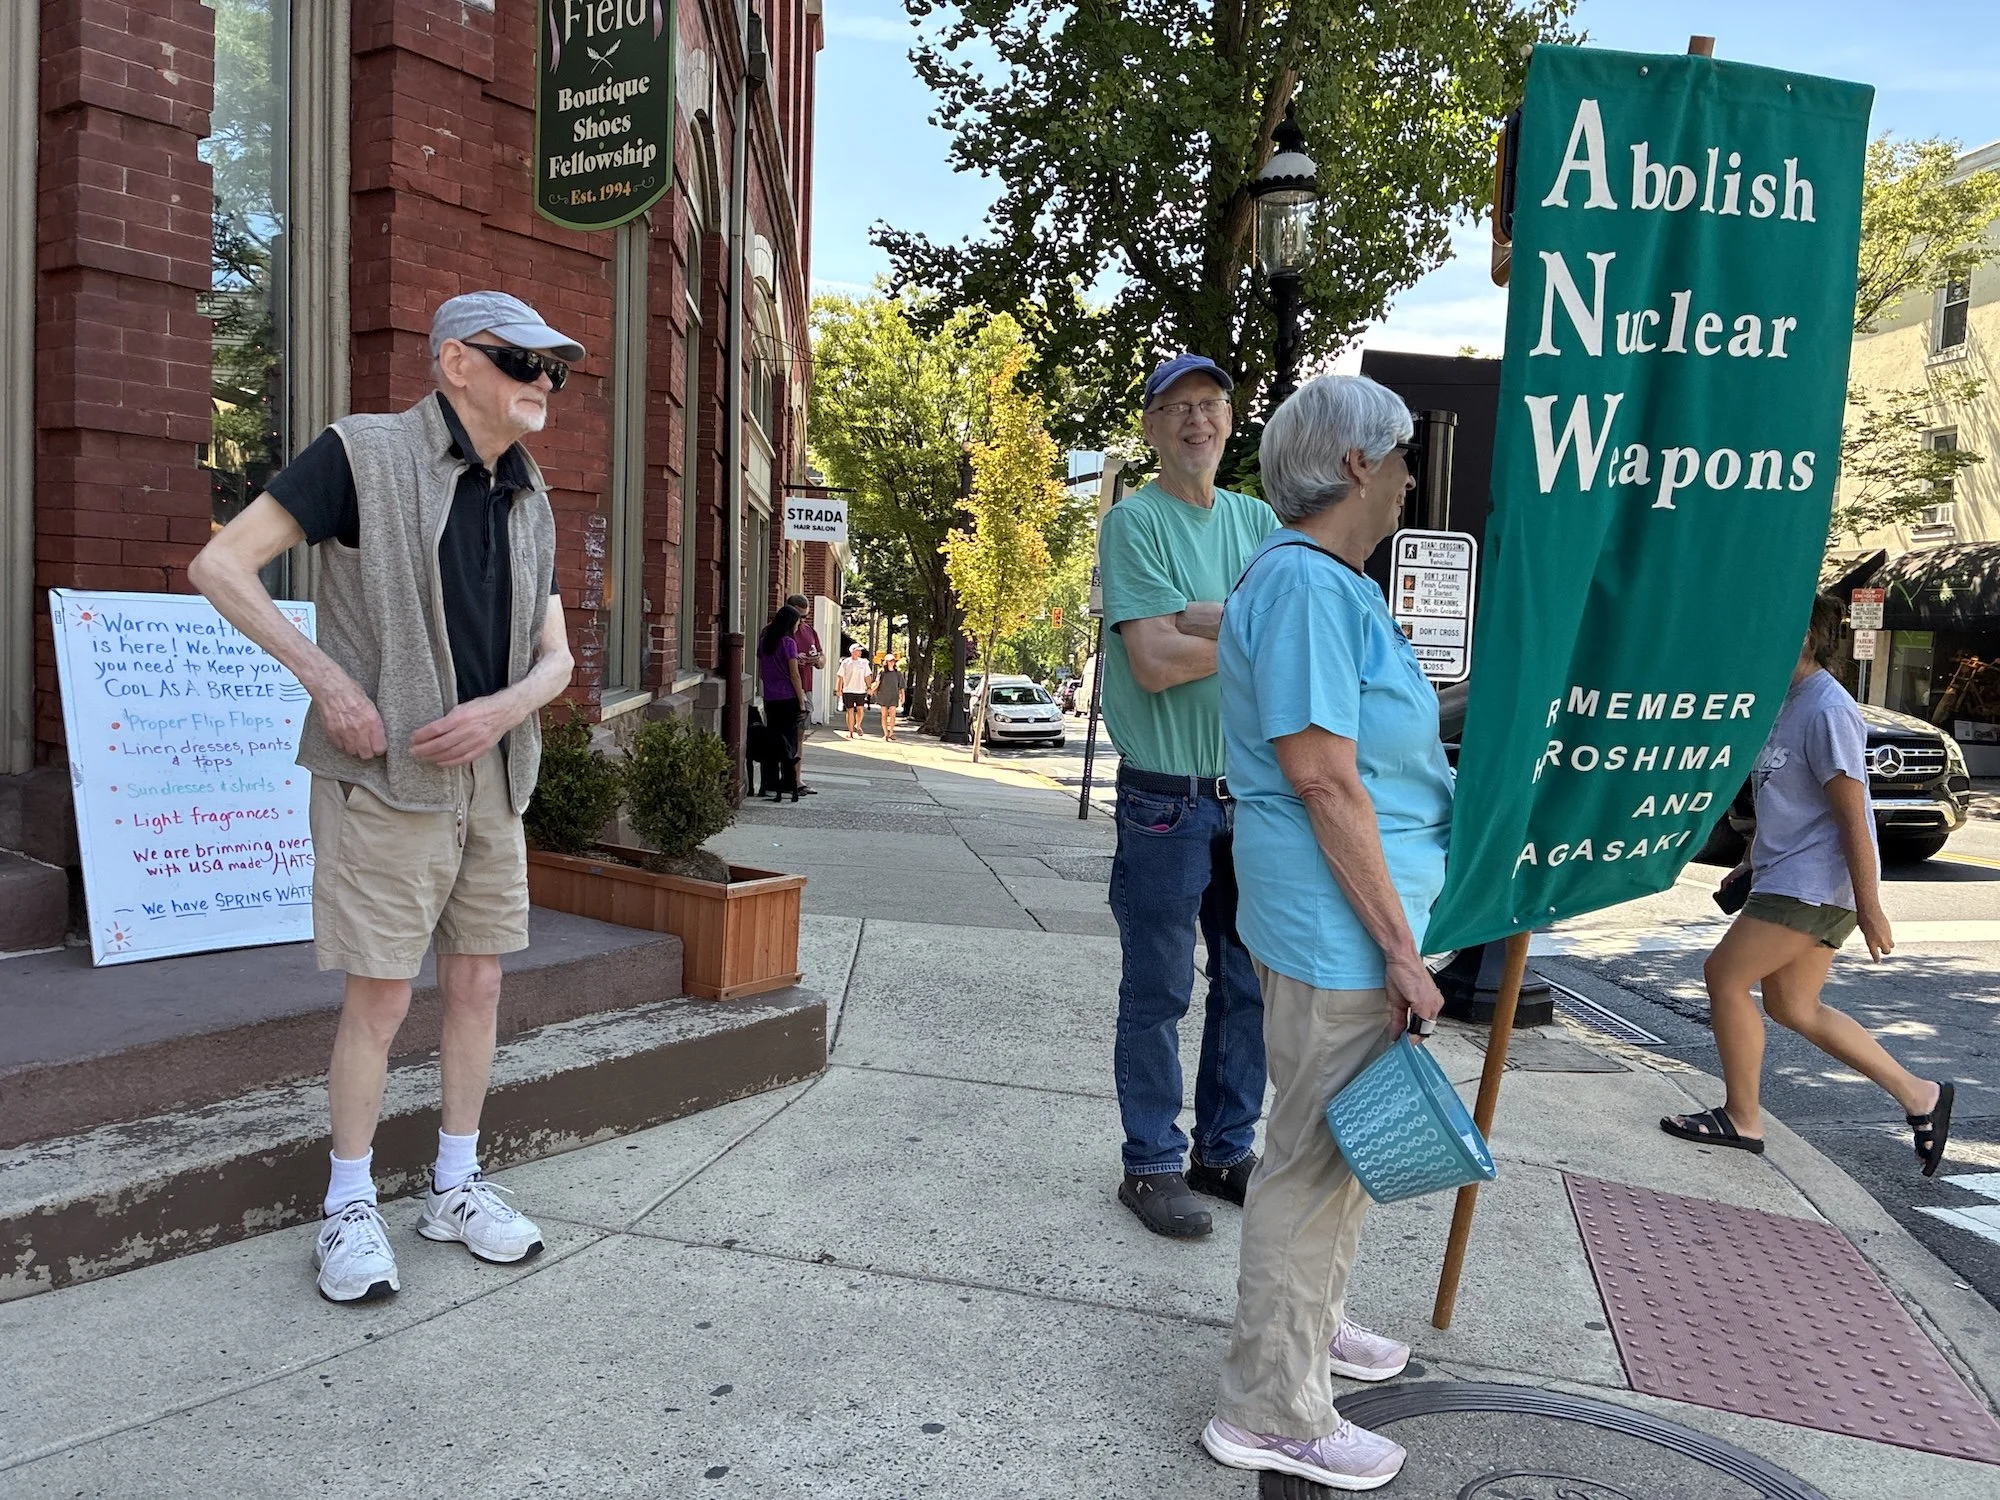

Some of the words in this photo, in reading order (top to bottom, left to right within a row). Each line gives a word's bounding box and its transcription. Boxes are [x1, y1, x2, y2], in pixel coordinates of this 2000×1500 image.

[564, 0, 647, 45] Field
[557, 76, 650, 112] Boutique
[573, 114, 631, 143] Shoes
[548, 138, 657, 179] Fellowship
[1540, 98, 1816, 223] Abolish
[570, 189, 597, 206] Est.
[599, 180, 632, 202] 1994
[1529, 251, 1797, 360] Nuclear
[1524, 393, 1816, 511] Weapons
[787, 508, 843, 523] STRADA
[1439, 542, 1465, 551] CROSSING
[1424, 572, 1439, 580] DON'T
[1442, 573, 1458, 581] START
[101, 613, 169, 635] Warm
[1419, 627, 1437, 636] DON'T
[1439, 628, 1459, 637] CROSS
[93, 637, 111, 653] is
[120, 635, 178, 658] here!
[187, 640, 210, 655] We
[215, 639, 256, 655] have
[1426, 648, 1451, 657] BUTTON
[94, 660, 127, 679] you
[133, 660, 174, 673] need
[183, 659, 201, 674] to
[104, 678, 154, 697] COOL
[160, 680, 181, 698] AS
[185, 680, 200, 697] A
[207, 681, 275, 700] BREEZE
[1545, 686, 1756, 728] RMEMBER
[125, 710, 188, 739] Proper
[191, 712, 225, 736] Flip
[229, 711, 275, 733] Flops
[122, 742, 177, 756] Linen
[248, 737, 292, 757] pants
[193, 755, 233, 772] tops
[1532, 740, 1731, 784] HROSHIMA
[231, 777, 276, 793] shorts
[1631, 791, 1713, 819] AND
[134, 810, 184, 834] Light
[191, 806, 280, 831] fragrances
[133, 849, 158, 863] We
[164, 846, 190, 859] are
[196, 839, 274, 862] brimming
[279, 838, 312, 849] over
[1511, 830, 1692, 880] AGASAKI
[146, 864, 181, 878] with
[228, 857, 262, 871] made
[272, 851, 316, 876] HATS
[142, 902, 166, 915] We
[171, 899, 209, 912] have
[214, 892, 272, 908] SPRING
[275, 885, 314, 902] WATE
